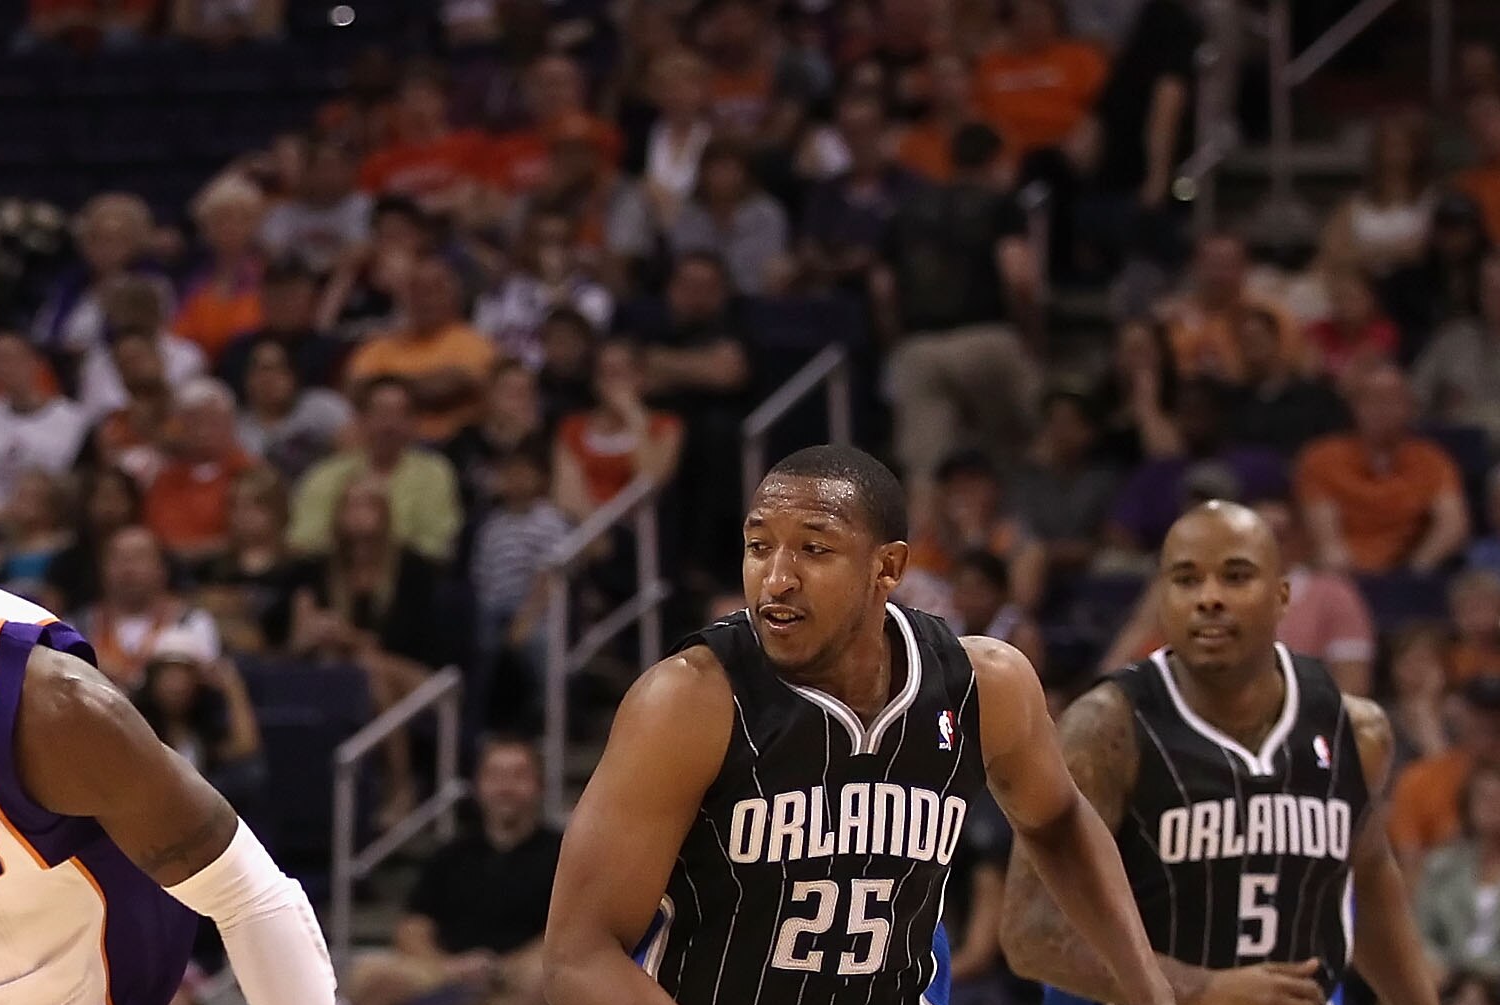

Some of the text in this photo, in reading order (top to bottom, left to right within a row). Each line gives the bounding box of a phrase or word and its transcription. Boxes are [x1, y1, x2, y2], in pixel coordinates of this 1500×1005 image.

[729, 782, 967, 866] ORLANDO
[1159, 793, 1350, 865] ORLANDO
[770, 878, 895, 975] 25
[1235, 873, 1279, 957] 5
